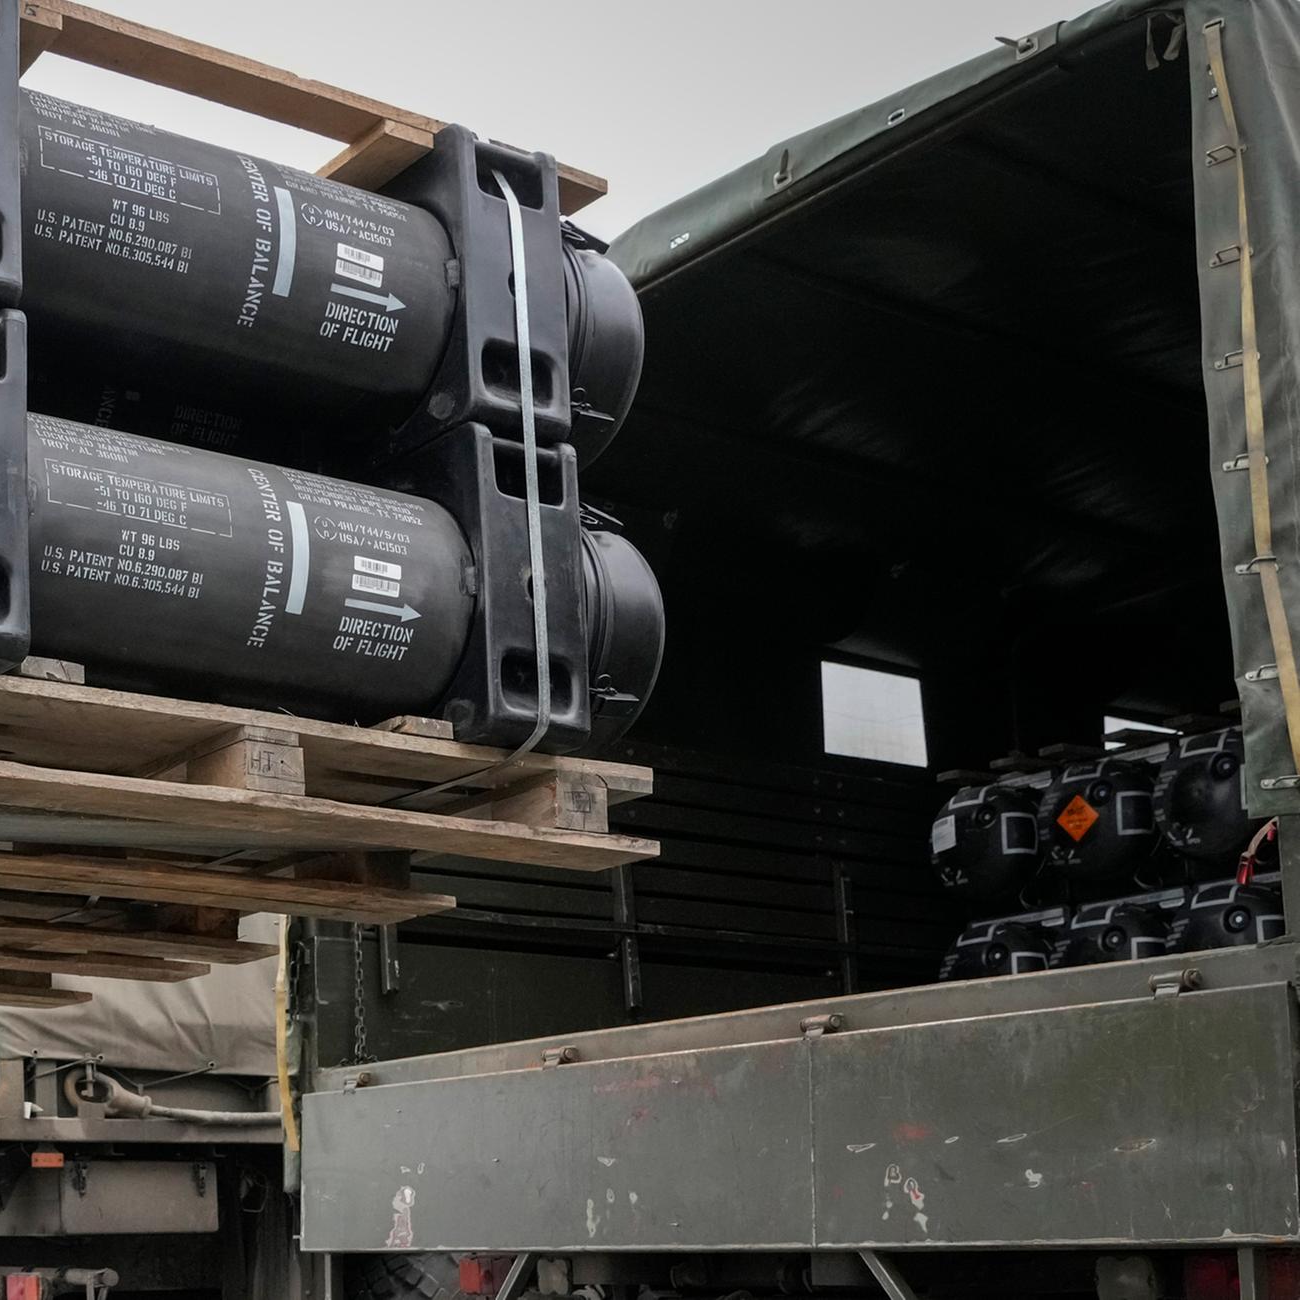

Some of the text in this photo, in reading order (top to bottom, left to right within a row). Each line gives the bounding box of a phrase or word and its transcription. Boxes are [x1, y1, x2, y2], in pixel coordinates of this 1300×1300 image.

[44, 131, 214, 186] STORAGE TEMPERATURE LIMITS
[86, 155, 177, 187] -51 TO 160 DEG F
[89, 168, 176, 200] -46 TO 71 DEG C
[37, 209, 58, 225] U.S.
[62, 215, 105, 237] PATENT
[110, 213, 145, 232] CU 8.9
[112, 198, 170, 224] WT 96 LBS
[34, 223, 55, 239] U.S.
[58, 230, 102, 251] PATENT
[237, 154, 272, 327] CENTER OF BALANCE
[325, 301, 399, 334] DIRECTION
[320, 321, 394, 352] OF FLIGHT
[51, 463, 225, 508] STORAGE TEMPERATURE LIMITS
[94, 485, 187, 512] -51 TO 160 DEG F
[97, 500, 187, 526] -46 TO 71 DEG C
[119, 544, 155, 562] CU 8.9
[121, 529, 180, 551] WT 96 LBS
[44, 545, 65, 560] U.S.
[69, 549, 114, 568] PATENT
[247, 468, 284, 648] CENTER OF BALANCE
[41, 560, 62, 575] U.S.
[66, 564, 111, 583] PATENT
[339, 616, 414, 643] DIRECTION
[333, 635, 408, 661] OF FLIGHT
